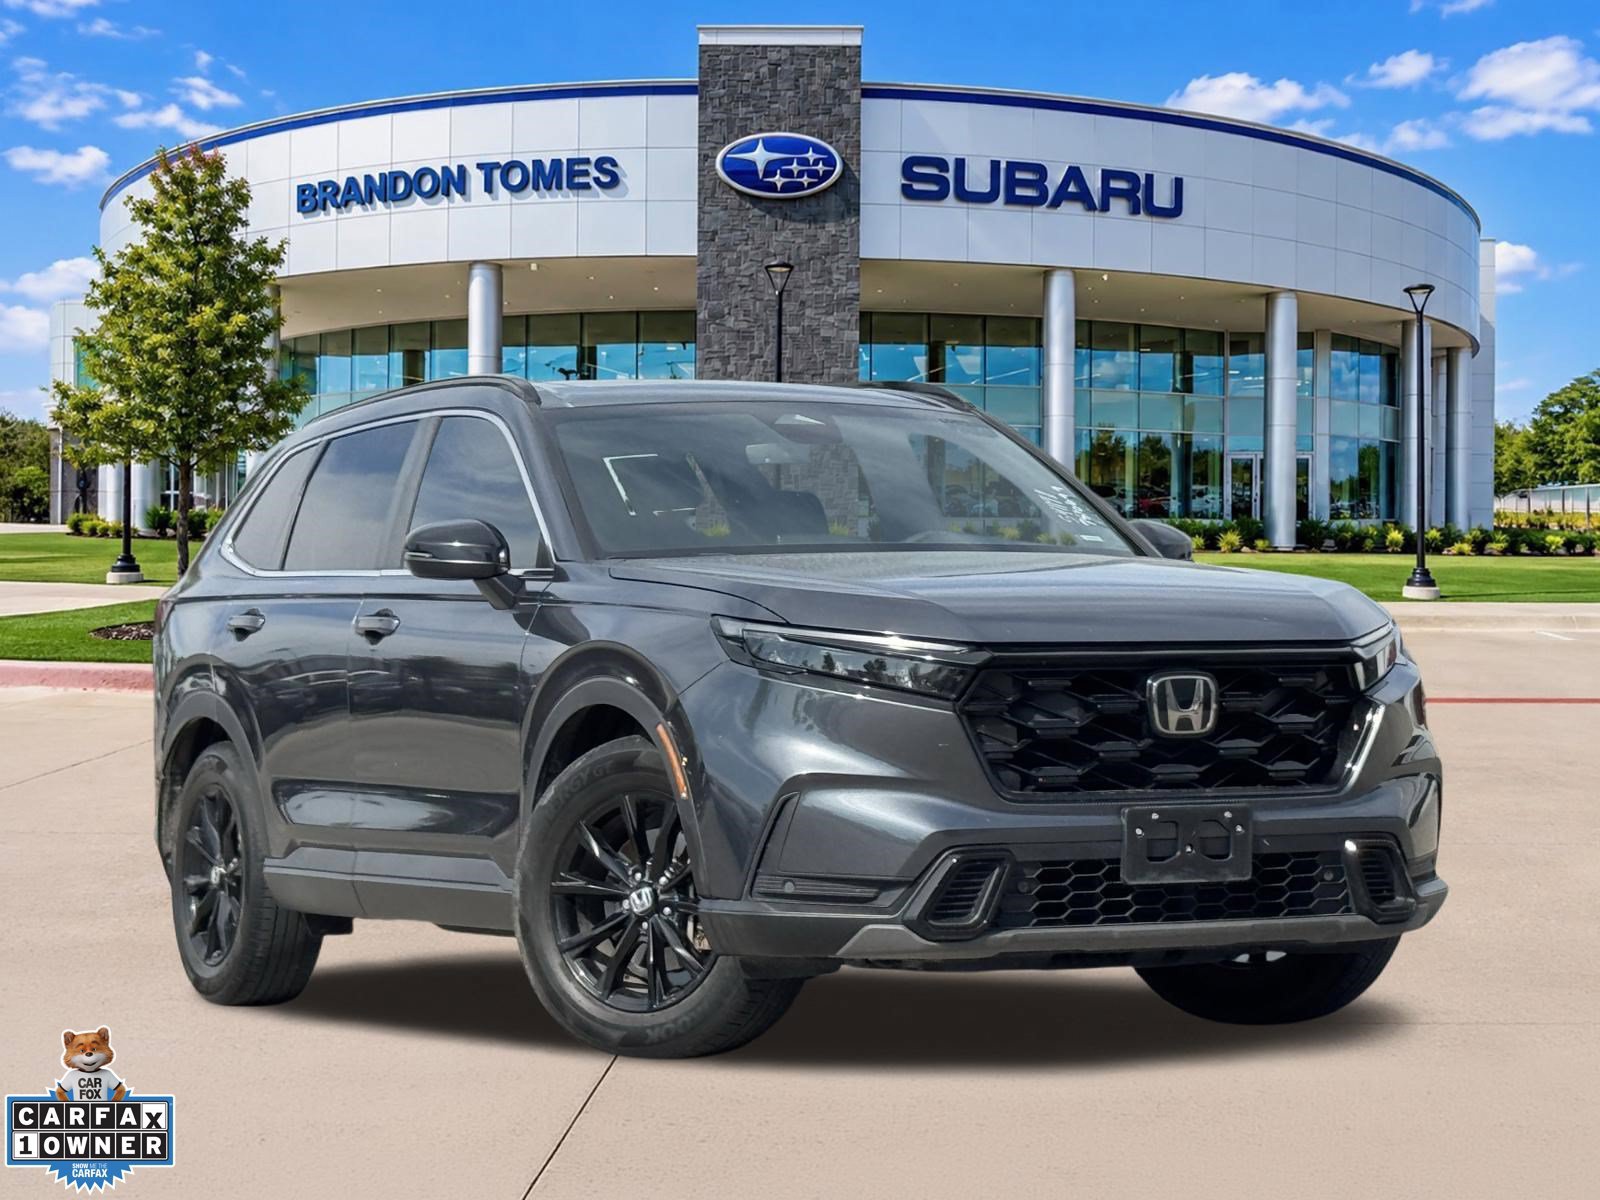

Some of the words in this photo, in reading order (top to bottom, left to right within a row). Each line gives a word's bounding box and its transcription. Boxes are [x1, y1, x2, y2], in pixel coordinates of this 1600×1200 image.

[297, 164, 466, 214] BRANDON
[476, 156, 621, 194] TOMES
[901, 155, 1184, 218] SUBARU
